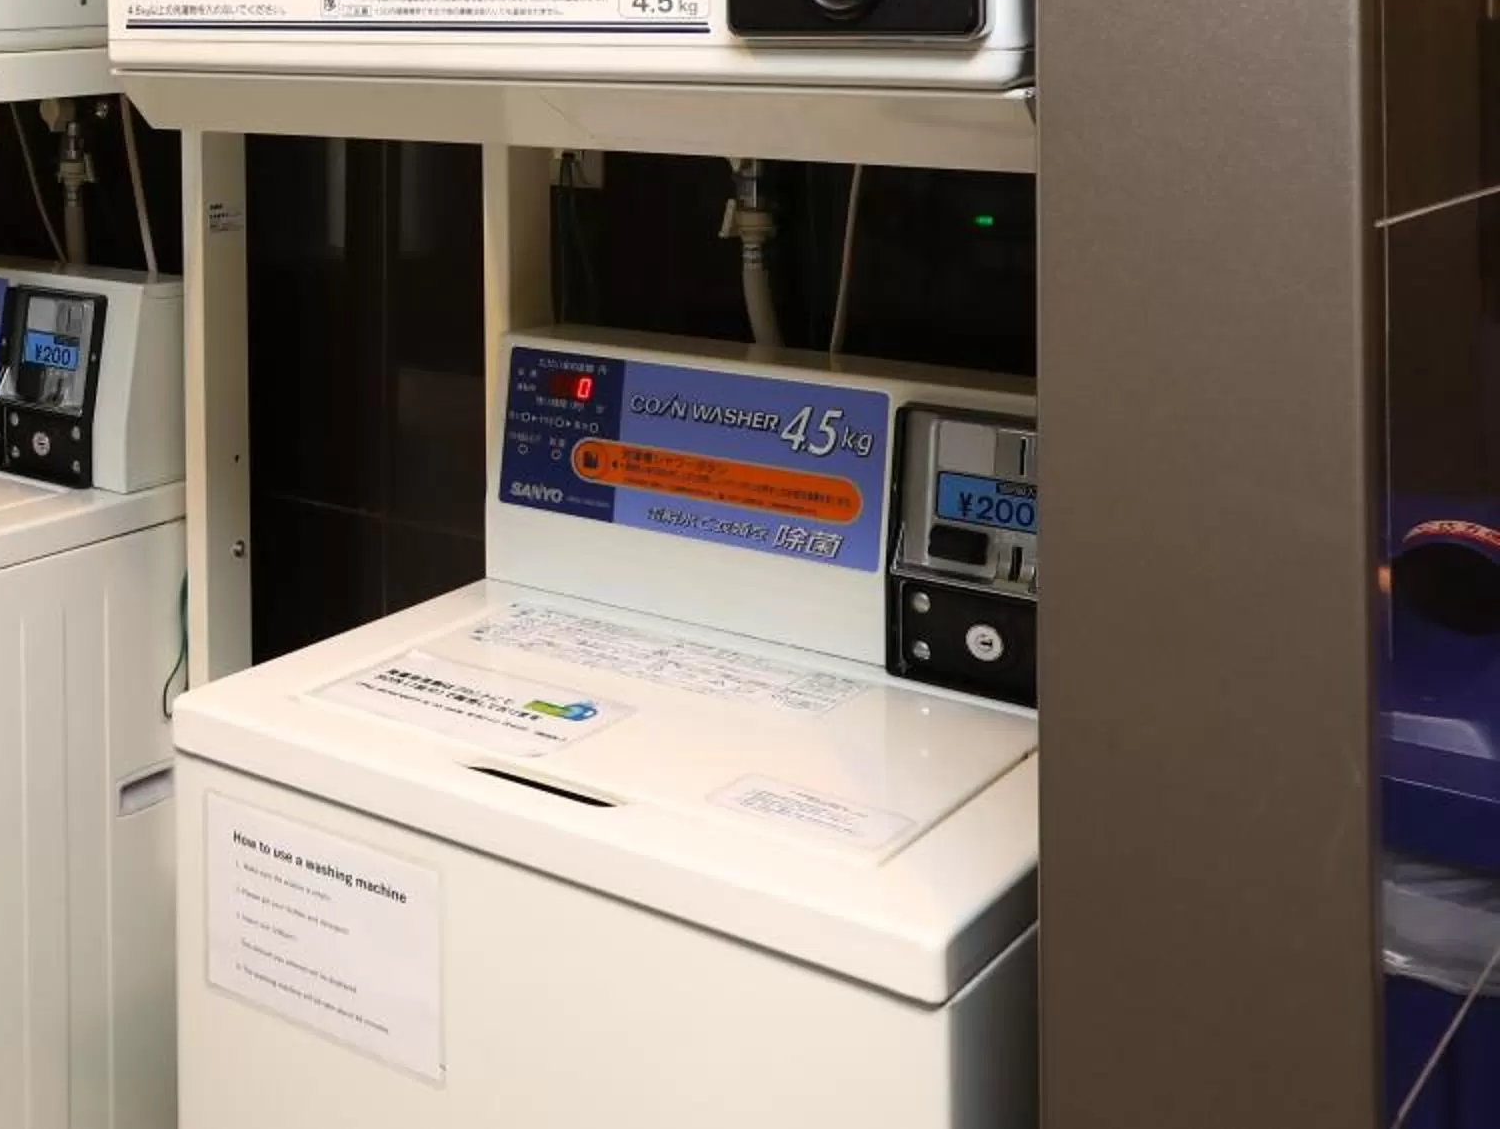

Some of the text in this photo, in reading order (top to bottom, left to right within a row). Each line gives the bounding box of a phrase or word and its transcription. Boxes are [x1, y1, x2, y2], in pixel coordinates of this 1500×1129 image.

[679, 0, 698, 15] kg
[35, 342, 71, 366] ¥200
[578, 377, 592, 399] 0
[693, 403, 779, 432] WASHER
[841, 425, 874, 457] kg
[510, 481, 564, 504] SANYO
[959, 491, 1034, 528] ¥200
[233, 830, 256, 848] How
[259, 841, 271, 855] to
[274, 848, 293, 863] use
[295, 856, 303, 866] a
[306, 861, 353, 887] washing
[356, 876, 407, 904] machine
